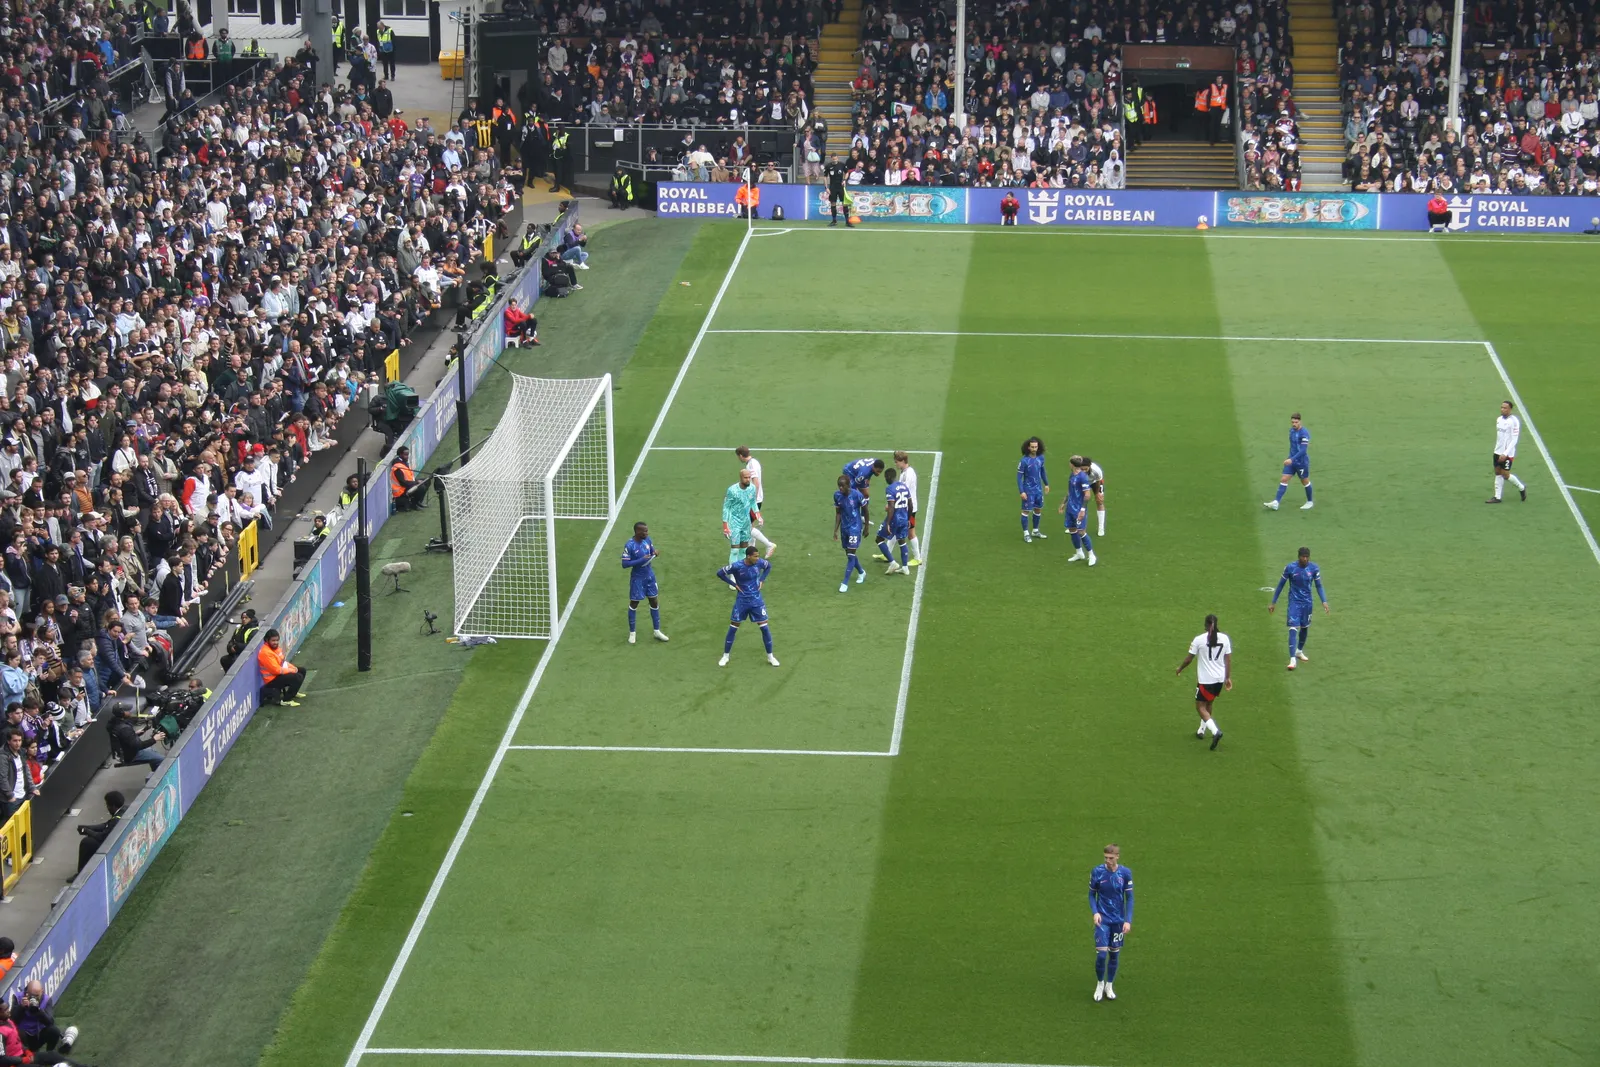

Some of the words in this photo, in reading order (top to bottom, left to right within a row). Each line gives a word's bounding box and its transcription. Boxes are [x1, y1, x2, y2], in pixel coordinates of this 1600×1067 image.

[659, 187, 708, 200] ROYAL
[1064, 194, 1115, 206] ROYAL
[1477, 200, 1529, 213] ROYAL
[1064, 209, 1156, 222] CARIBBEAN
[1477, 215, 1571, 228] CARIBBEAN
[894, 490, 909, 509] 25
[848, 534, 859, 544] 23
[761, 608, 767, 616] 6
[1206, 642, 1224, 661] 17
[216, 689, 237, 730] ROYAL
[217, 691, 252, 754] CARIBBEAN
[1112, 932, 1124, 943] 20
[44, 940, 77, 998] IBBEAN
